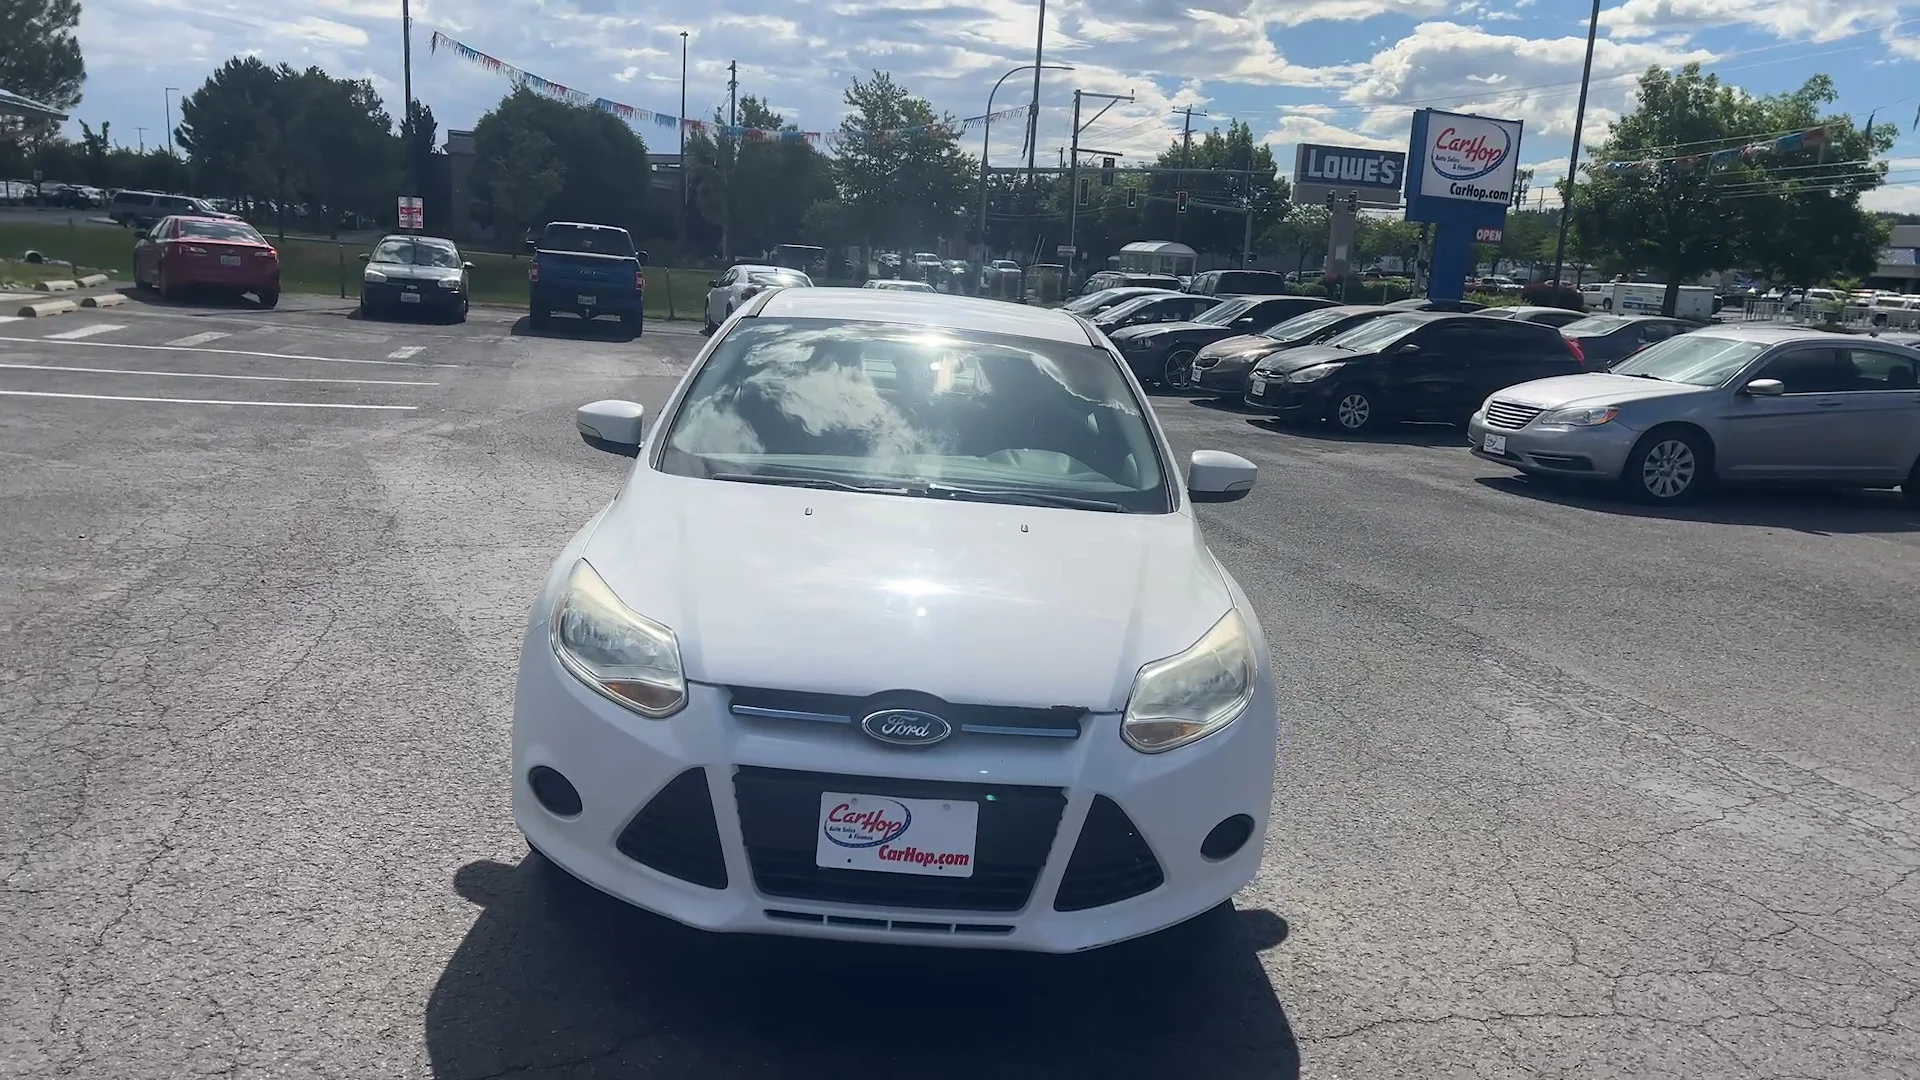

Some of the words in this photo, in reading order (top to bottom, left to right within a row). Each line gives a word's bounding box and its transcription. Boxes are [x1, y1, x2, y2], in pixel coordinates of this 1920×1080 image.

[1436, 127, 1502, 171] CarHop
[1308, 149, 1396, 184] LOWE'S
[1450, 182, 1509, 201] CarHop.com
[1476, 229, 1503, 241] OPEN
[881, 714, 931, 737] Ford
[828, 803, 902, 841] CarHop
[878, 844, 970, 866] CarHop.com
